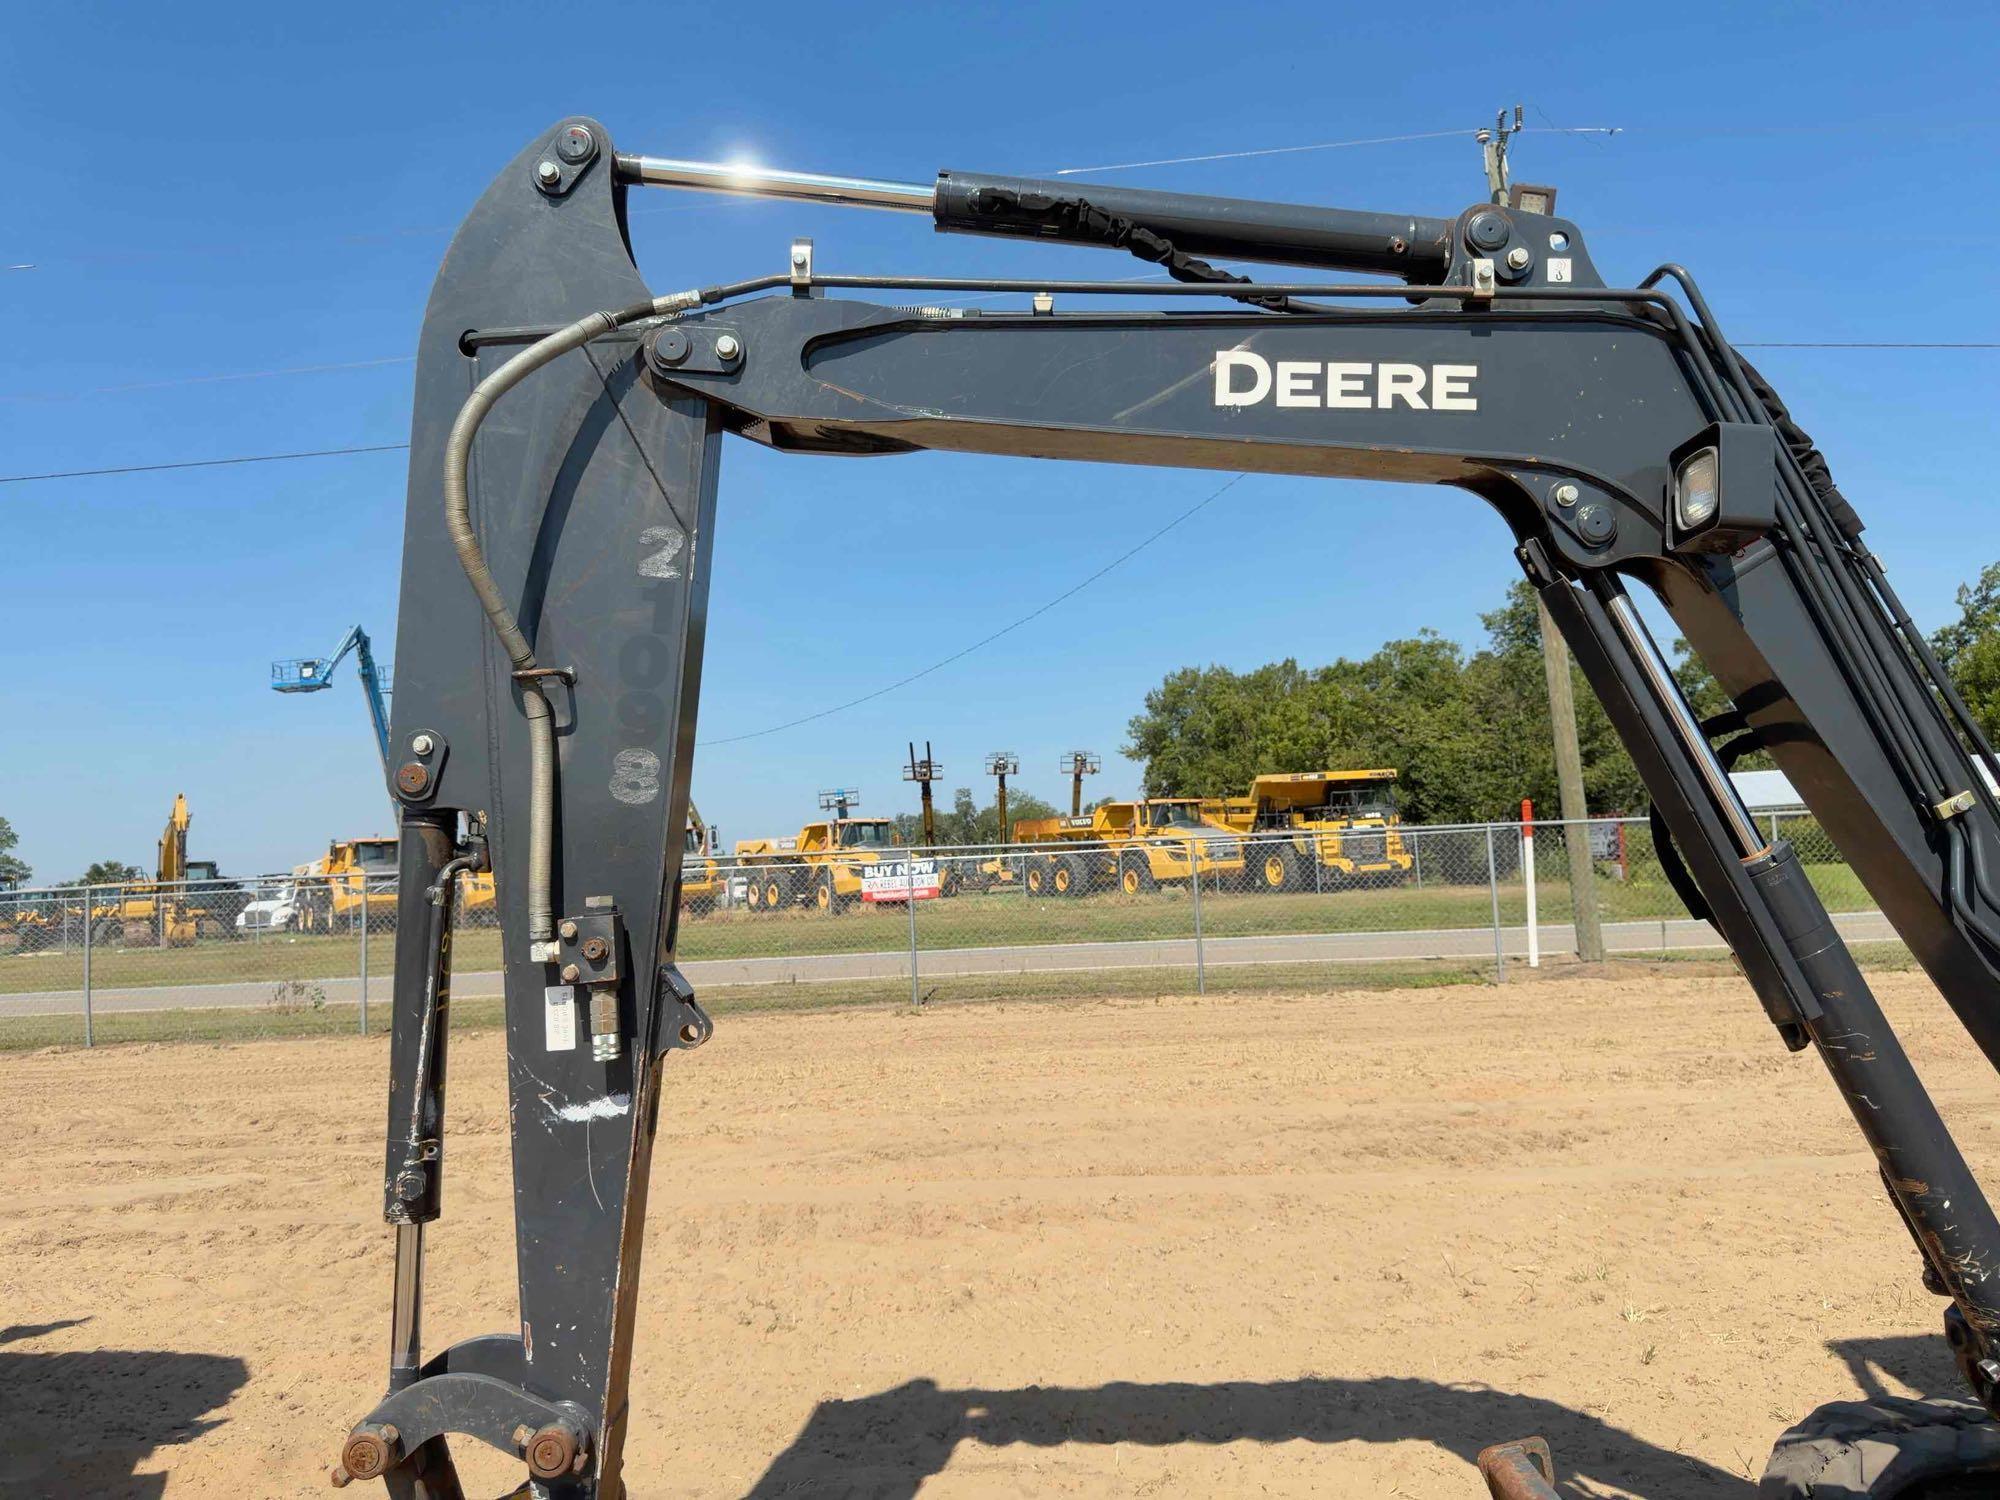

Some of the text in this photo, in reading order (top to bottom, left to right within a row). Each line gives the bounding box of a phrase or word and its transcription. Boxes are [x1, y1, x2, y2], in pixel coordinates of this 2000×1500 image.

[1213, 350, 1478, 411] DEERE
[864, 861, 933, 878] BUY NOW
